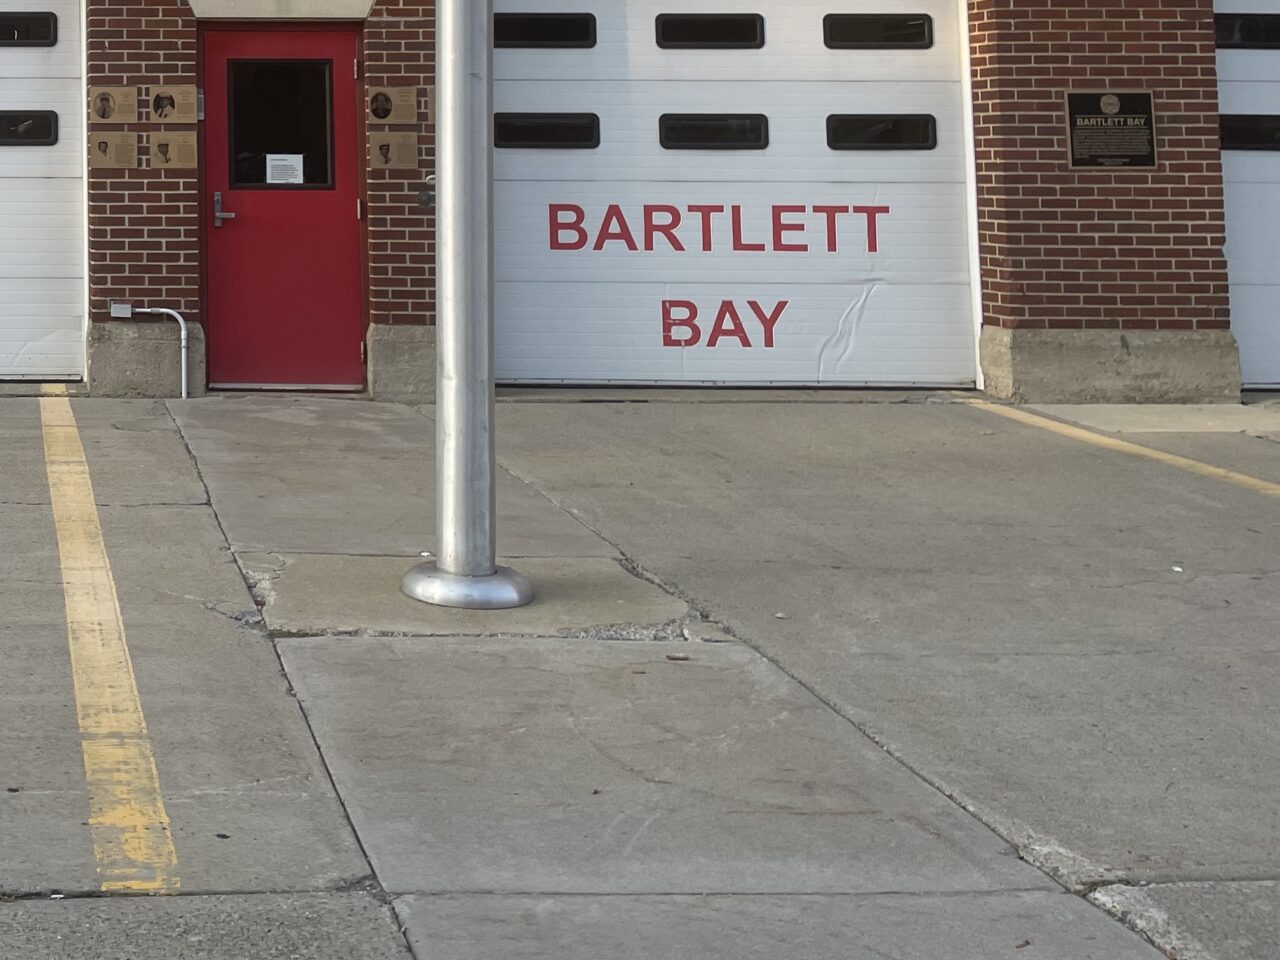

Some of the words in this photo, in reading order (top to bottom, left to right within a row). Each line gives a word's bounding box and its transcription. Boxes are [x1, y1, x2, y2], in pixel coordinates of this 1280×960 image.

[1076, 118, 1124, 126] BARTLETT
[1127, 118, 1146, 126] BAY
[548, 203, 891, 253] BARTLETT
[661, 299, 790, 349] BAY
